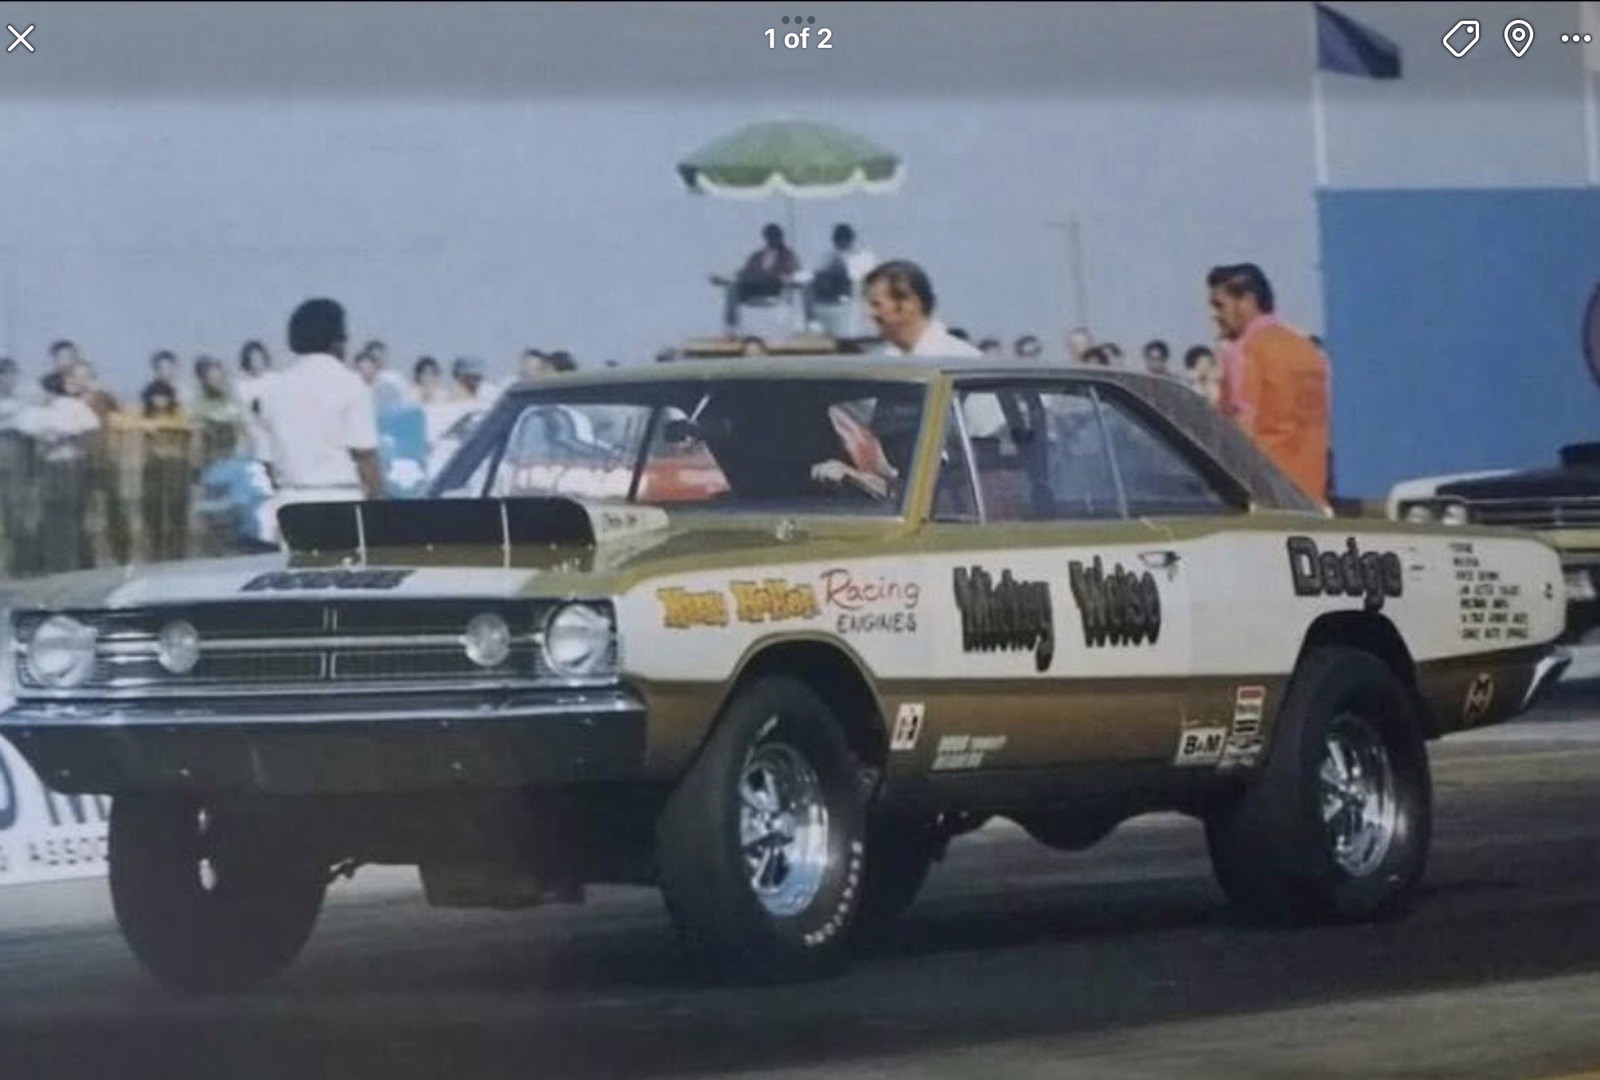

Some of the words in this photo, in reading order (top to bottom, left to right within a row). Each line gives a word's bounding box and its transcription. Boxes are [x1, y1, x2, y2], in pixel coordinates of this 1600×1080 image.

[819, 568, 919, 610] Racing
[1287, 535, 1403, 612] Dodge
[836, 612, 917, 634] ENGINES
